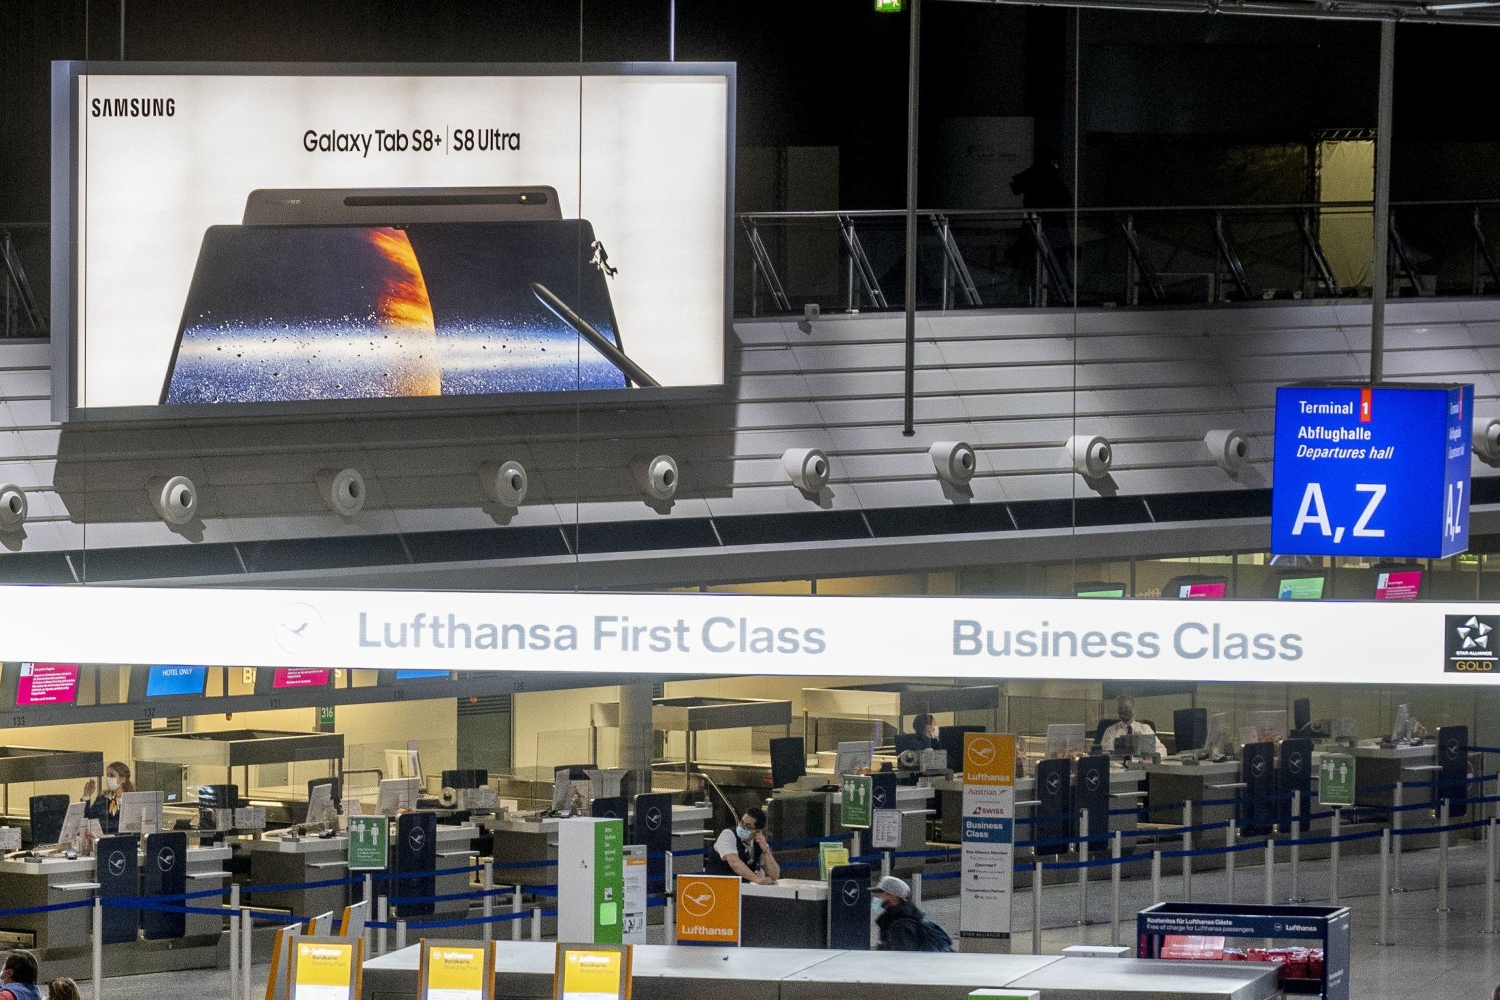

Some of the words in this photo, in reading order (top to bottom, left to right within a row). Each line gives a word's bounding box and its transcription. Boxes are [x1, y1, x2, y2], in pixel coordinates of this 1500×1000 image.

[91, 98, 176, 117] SAMSUNG
[303, 129, 372, 158] Galaxy
[375, 129, 409, 152] Tab
[411, 129, 442, 151] S8+
[453, 128, 474, 151] S8
[478, 128, 521, 151] Ultra
[1299, 401, 1353, 415] Terminal
[1363, 402, 1369, 414] 1
[1298, 426, 1372, 442] Abflughalle
[1296, 445, 1366, 460] Departures
[1369, 446, 1394, 460] hall
[1291, 482, 1387, 544] A,Z
[358, 612, 578, 651] Lufthansa
[594, 615, 690, 653] First
[701, 616, 826, 655] Class
[952, 619, 1160, 661] Business
[1173, 622, 1304, 661] Class
[1456, 661, 1492, 671] GOLD
[162, 668, 178, 677] HOTEL
[179, 668, 192, 676] ONLY
[321, 707, 334, 719] 316
[967, 773, 1010, 782] Lufthansa
[968, 788, 997, 796] Austrian
[966, 821, 1003, 830] Business
[966, 830, 988, 838] Class
[682, 925, 733, 935] Lufthansa
